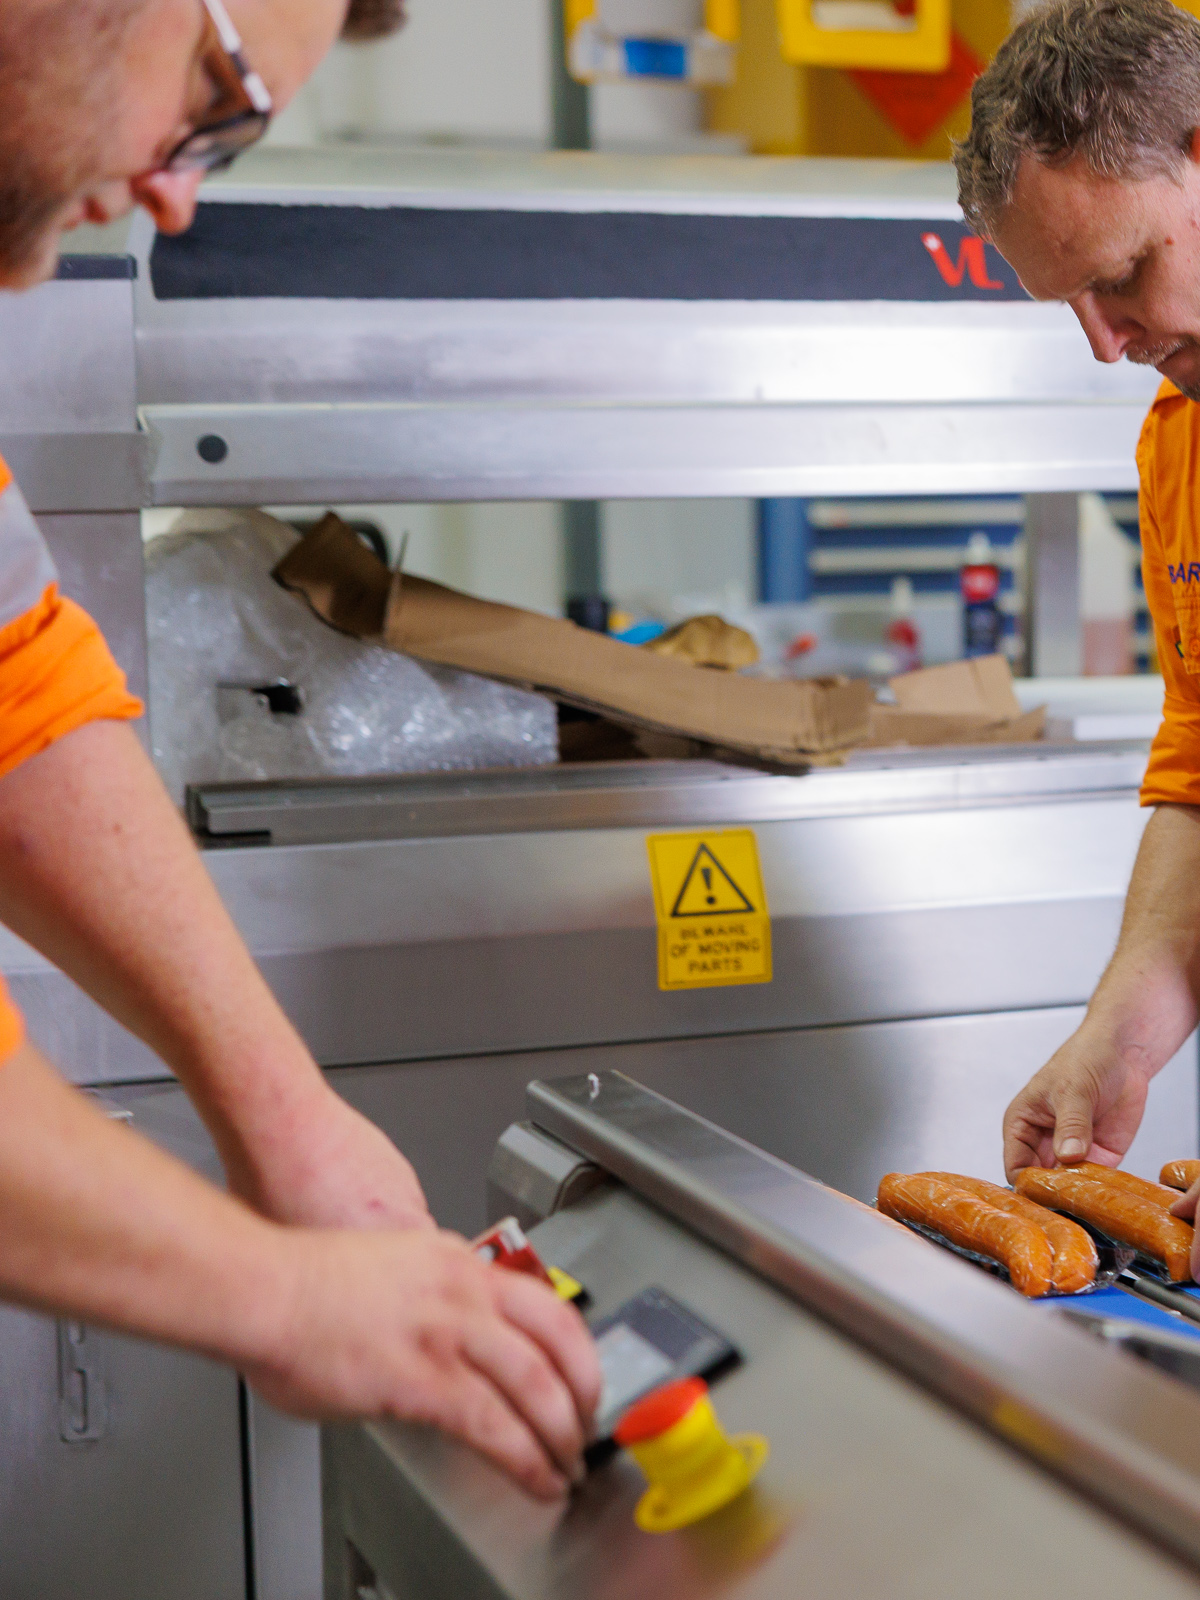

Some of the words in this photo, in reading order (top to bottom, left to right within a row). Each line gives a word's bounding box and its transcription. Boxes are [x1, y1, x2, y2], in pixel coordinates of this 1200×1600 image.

[671, 943, 689, 958] OF
[698, 938, 760, 955] MOVING
[688, 957, 742, 973] PARTS
